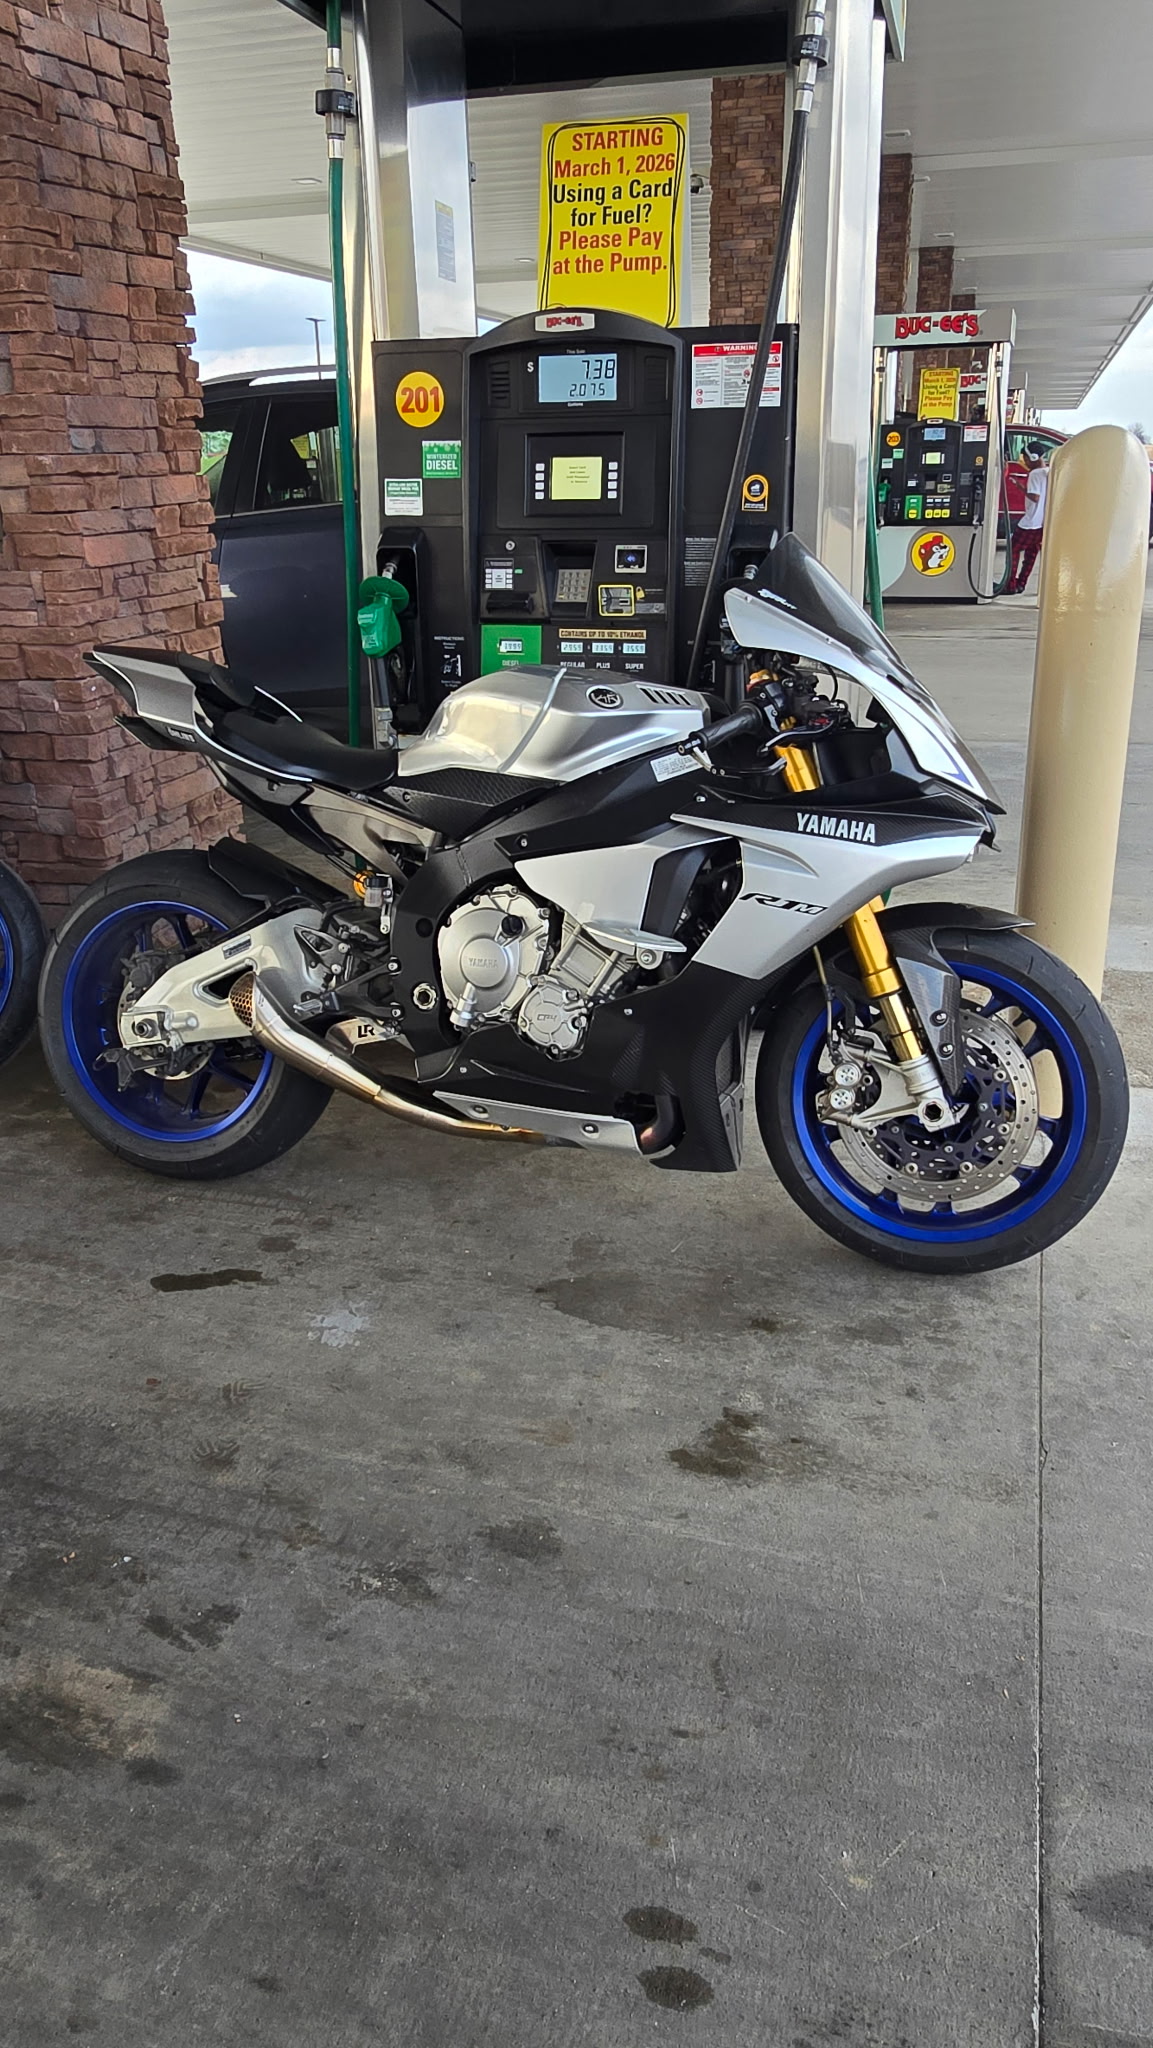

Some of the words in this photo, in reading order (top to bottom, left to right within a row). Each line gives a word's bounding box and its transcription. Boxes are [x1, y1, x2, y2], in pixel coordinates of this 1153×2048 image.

[572, 127, 663, 152] STARTING
[554, 157, 611, 178] March
[617, 156, 630, 176] 1,
[635, 153, 675, 173] 2026
[553, 183, 605, 205] Using
[612, 186, 622, 199] a
[629, 177, 673, 199] Card
[570, 208, 596, 227] for
[602, 203, 652, 225] Fuel?
[559, 230, 621, 250] Please
[628, 226, 663, 250] Pay
[552, 259, 570, 275] at
[575, 254, 604, 273] the
[610, 252, 667, 275] Pump.
[895, 313, 979, 339] BUC-EE'S
[581, 359, 615, 380] 7.38
[401, 386, 440, 414] 201
[569, 383, 605, 397] 2.075
[426, 460, 458, 471] DIESEL
[797, 812, 876, 843] YAMAHA
[469, 957, 499, 969] YAMAHA
